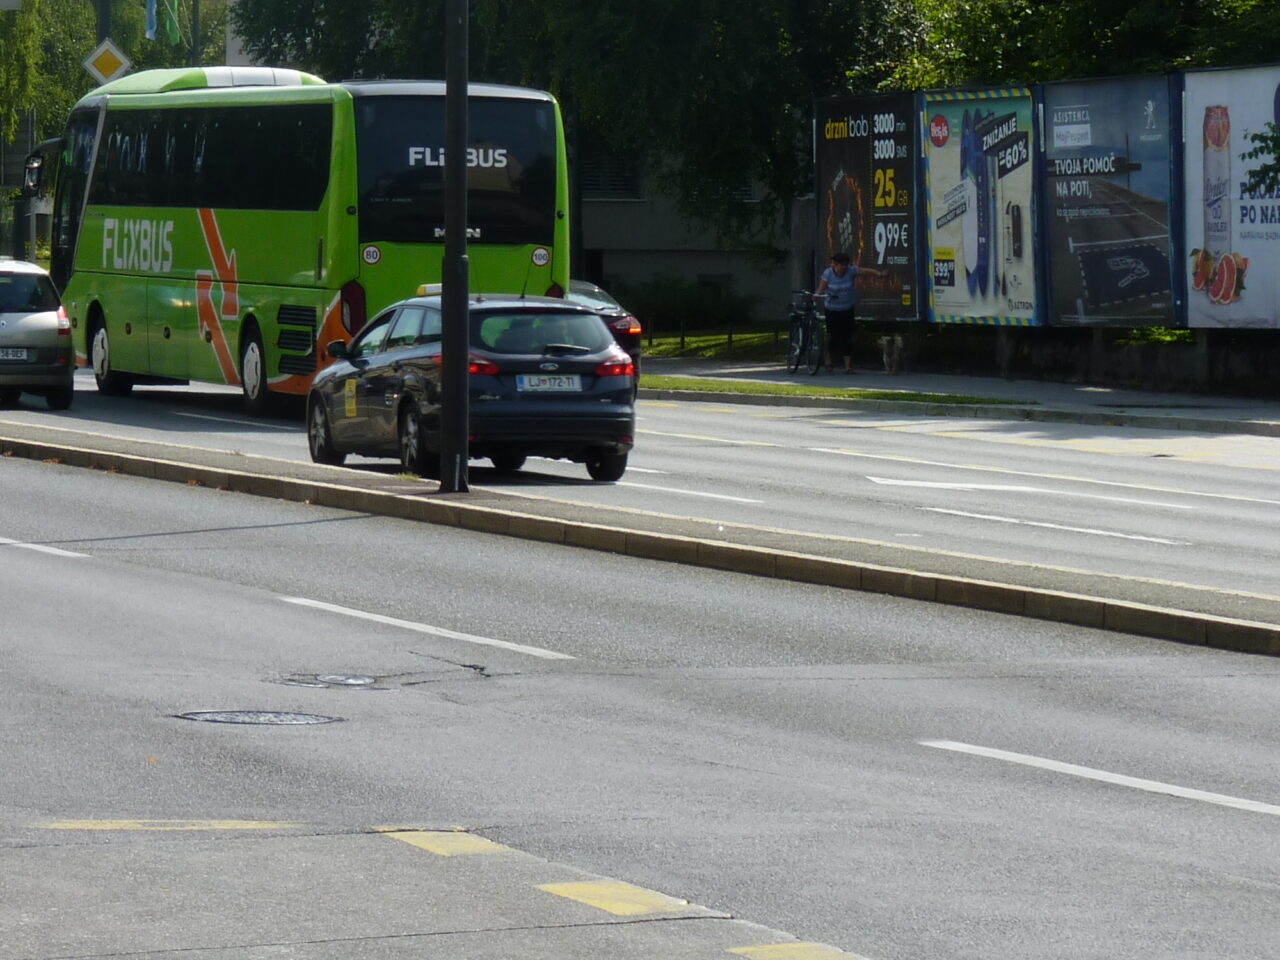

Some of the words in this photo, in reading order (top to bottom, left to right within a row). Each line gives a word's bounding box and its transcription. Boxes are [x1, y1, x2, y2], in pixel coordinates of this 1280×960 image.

[873, 113, 894, 134] 3000
[1053, 110, 1090, 123] ASISTENCA
[825, 117, 847, 140] drzni
[849, 115, 869, 137] bob
[982, 118, 1017, 151] ZNIŽANJE
[873, 139, 894, 159] 3000
[1055, 158, 1081, 175] TVOJA
[1083, 152, 1115, 173] POMOČ
[874, 168, 896, 207] 25
[897, 190, 908, 207] GB
[1056, 181, 1068, 197] NA
[1070, 180, 1092, 199] POTI,
[1240, 205, 1257, 224] PO
[434, 227, 481, 239] MN
[366, 250, 378, 260] 80
[534, 253, 547, 261] 100
